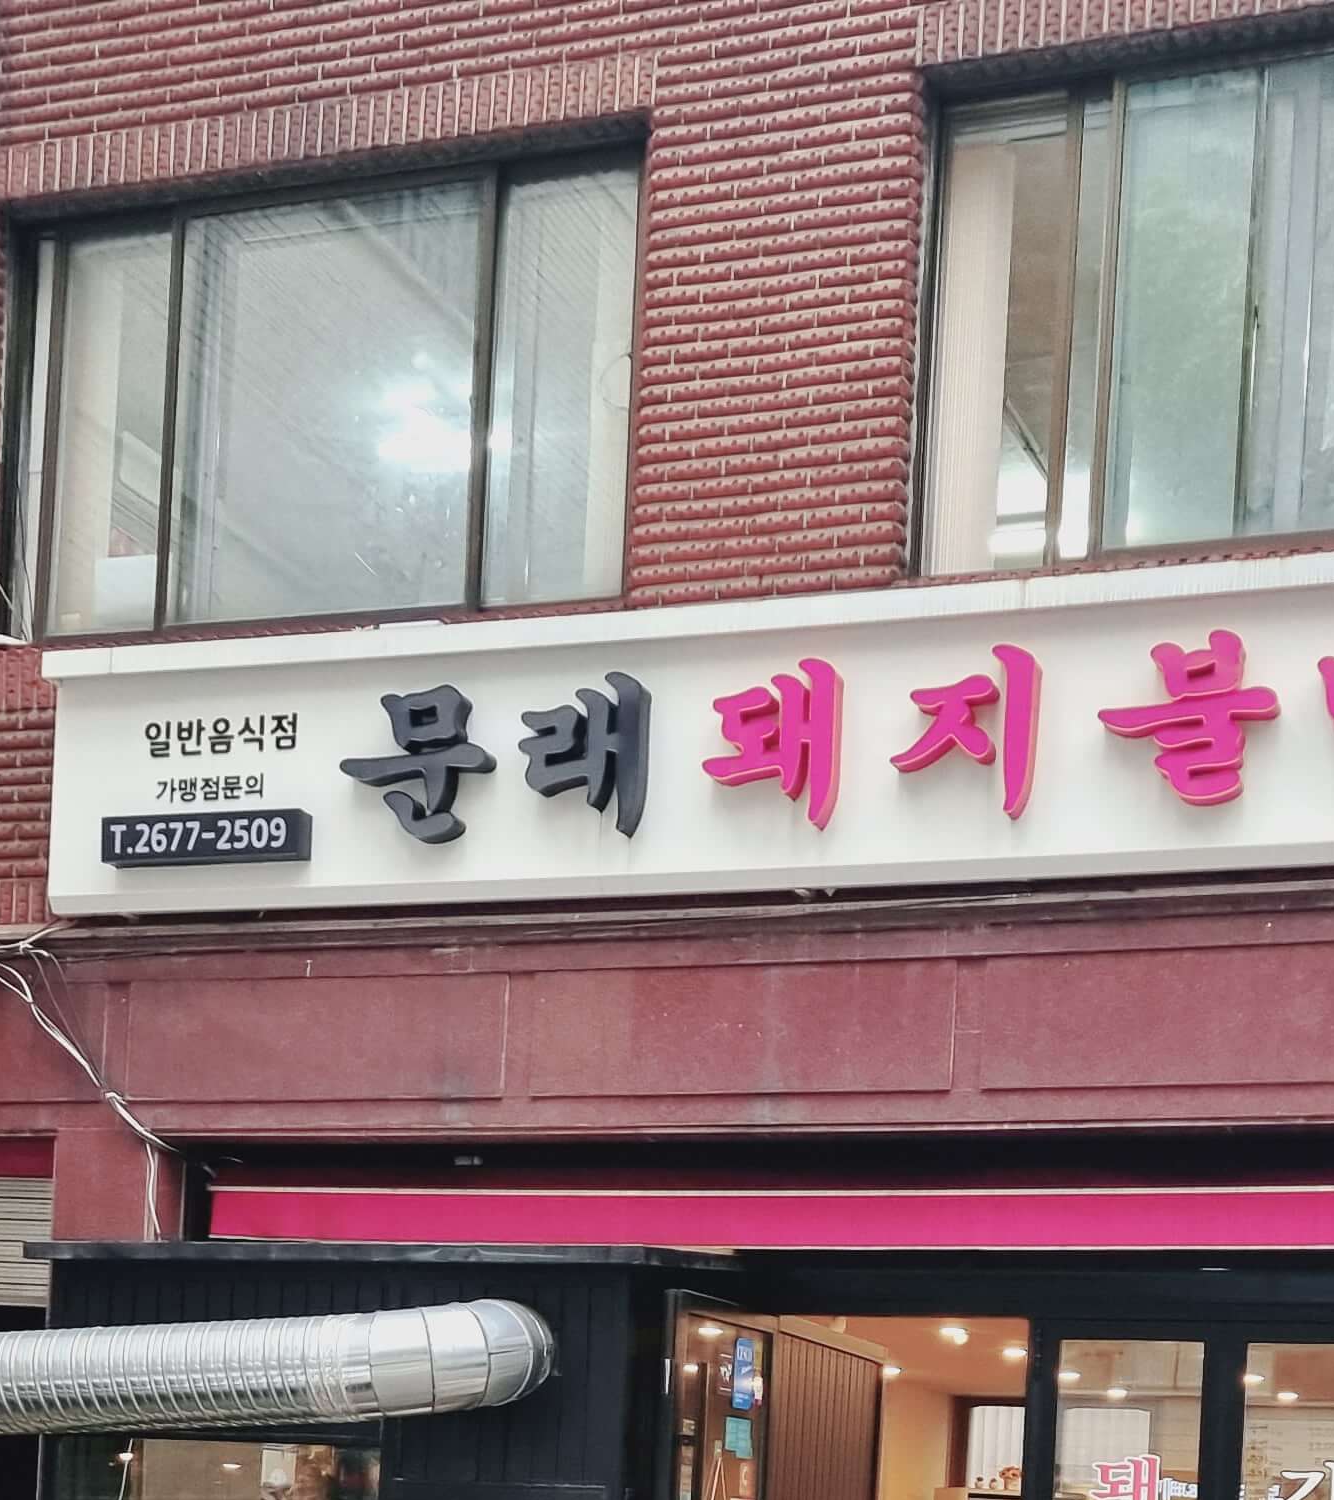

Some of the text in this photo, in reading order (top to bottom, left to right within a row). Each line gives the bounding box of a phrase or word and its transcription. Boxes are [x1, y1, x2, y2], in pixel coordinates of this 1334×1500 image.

[144, 712, 298, 758] 일반음식점
[156, 772, 265, 803] 가맹점문의
[109, 816, 288, 855] T.2677-2509
